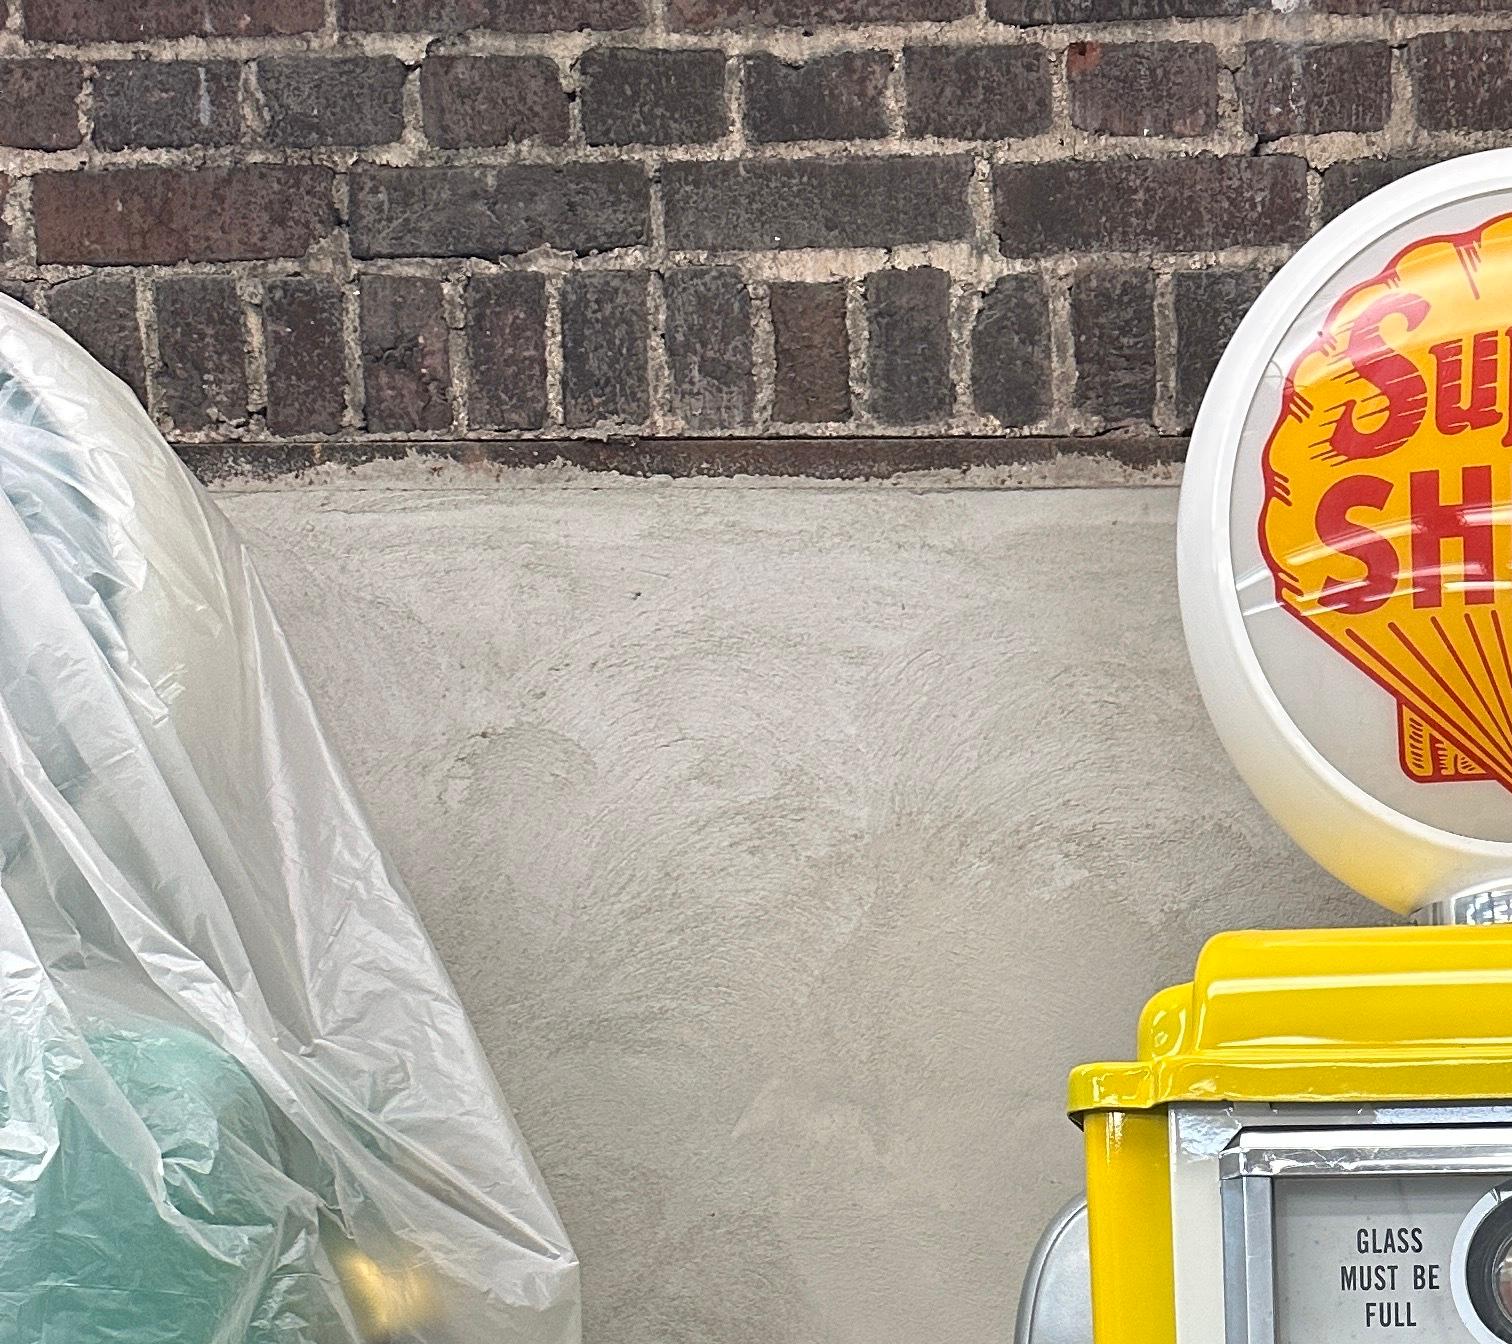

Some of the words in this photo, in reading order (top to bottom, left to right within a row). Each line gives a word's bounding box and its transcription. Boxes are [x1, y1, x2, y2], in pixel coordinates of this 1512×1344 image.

[1356, 1227, 1423, 1255] GLASS
[1340, 1264, 1399, 1291] MUST
[1413, 1264, 1440, 1290] BE
[1365, 1301, 1417, 1328] FULL
